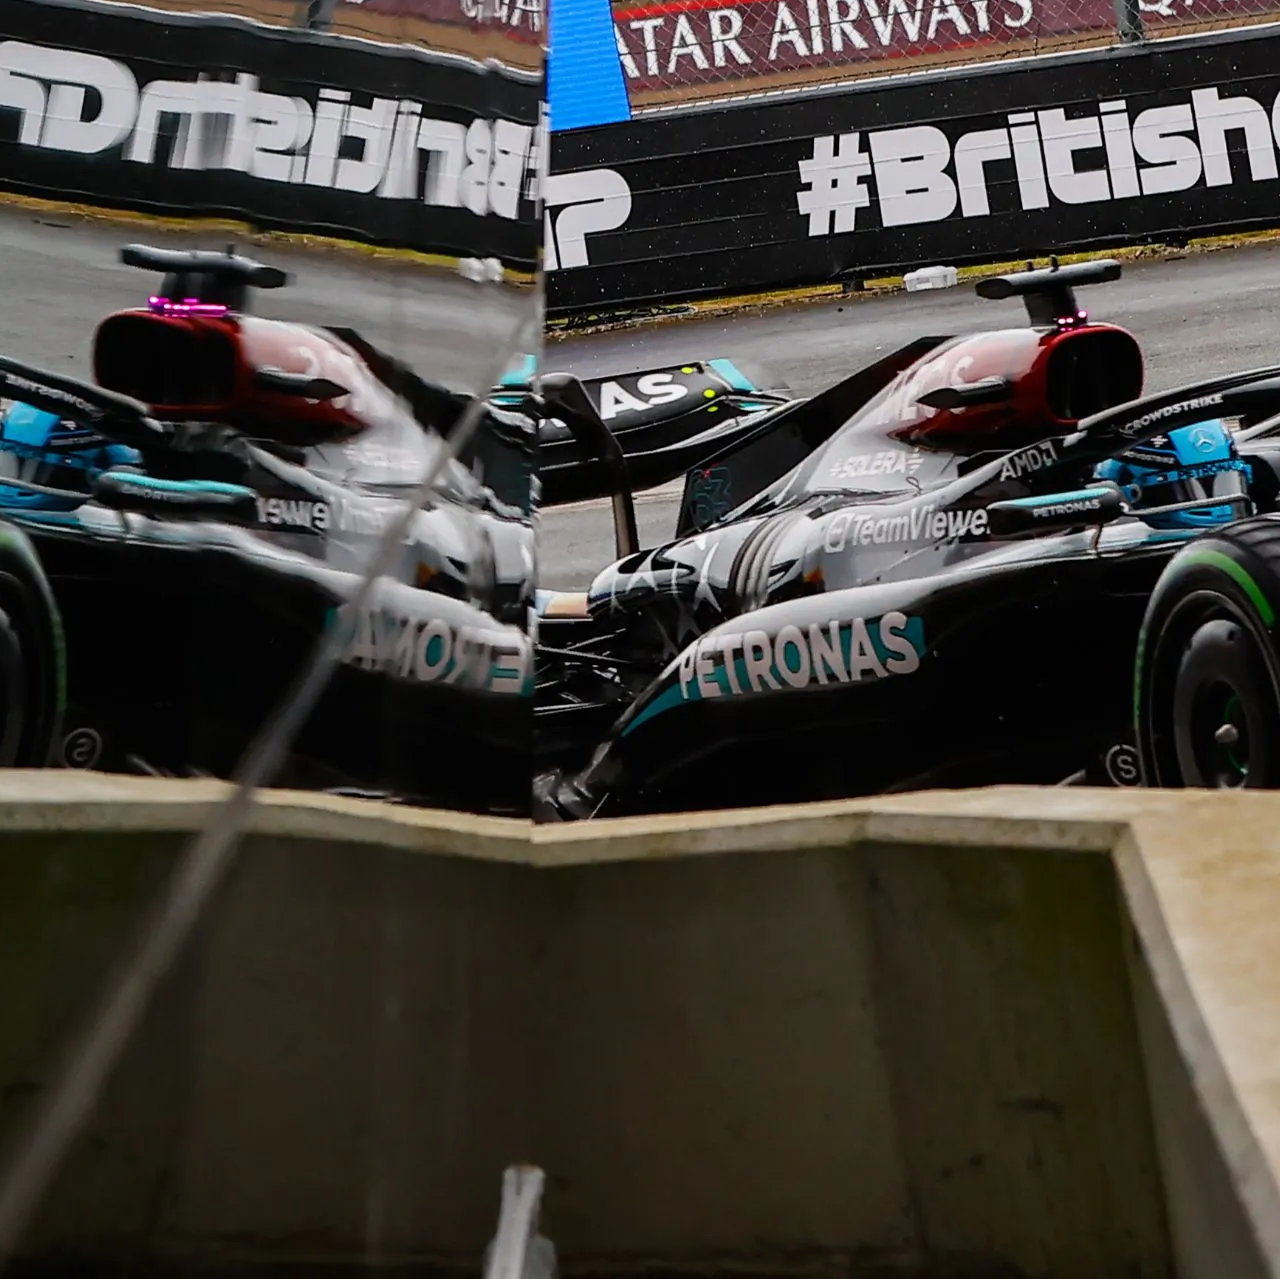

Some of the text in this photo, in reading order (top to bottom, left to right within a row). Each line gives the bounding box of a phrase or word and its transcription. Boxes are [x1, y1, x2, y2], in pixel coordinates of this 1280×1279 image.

[600, 373, 688, 420] AS
[1124, 393, 1224, 435] CROWDSTRIKE
[1000, 450, 1043, 481] AMD
[1033, 500, 1101, 518] PETRONAS
[679, 611, 920, 700] PETRONAS
